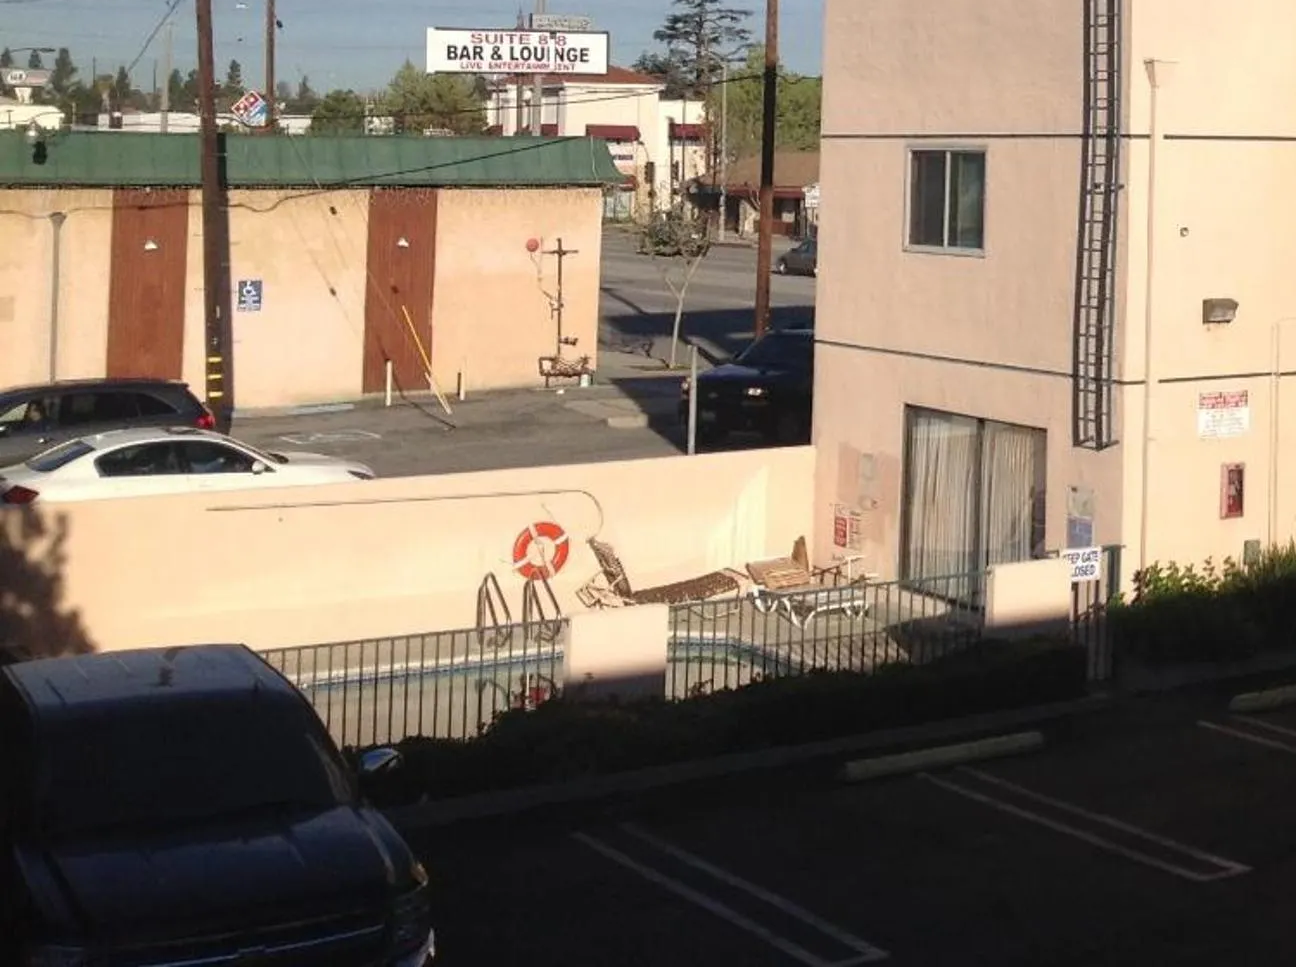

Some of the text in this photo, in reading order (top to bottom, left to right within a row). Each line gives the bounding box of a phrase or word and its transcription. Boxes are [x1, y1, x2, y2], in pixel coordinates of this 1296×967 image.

[470, 33, 531, 45] SUITE
[446, 45, 484, 61] BAR
[490, 46, 502, 60] &
[460, 62, 483, 70] LIVE
[1071, 564, 1096, 577] LOSED
